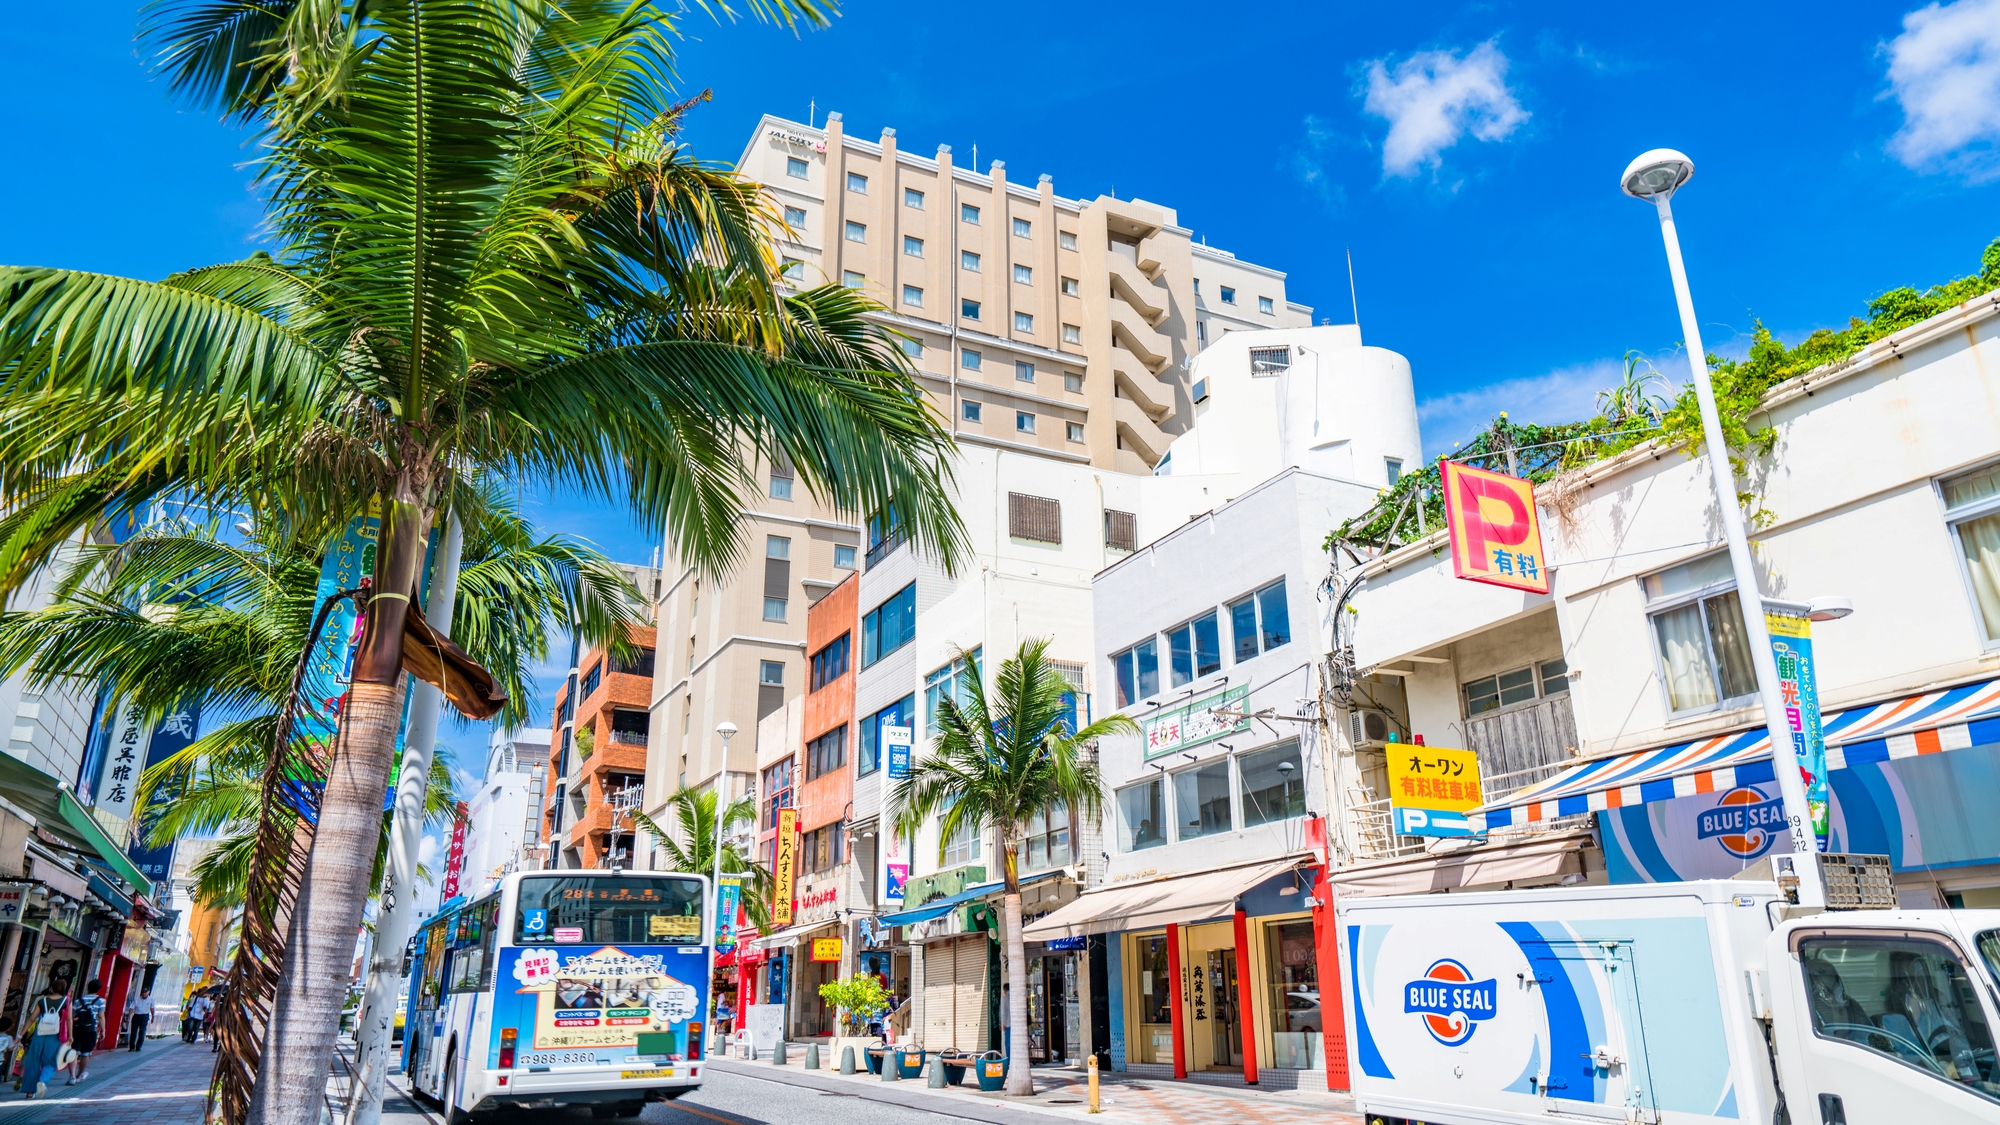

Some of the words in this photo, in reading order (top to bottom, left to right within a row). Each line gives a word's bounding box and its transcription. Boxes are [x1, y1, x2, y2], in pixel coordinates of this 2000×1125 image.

[768, 131, 787, 140] JAL
[788, 135, 814, 146] CITY
[1457, 471, 1530, 572] P
[1492, 548, 1538, 581] 有料
[1800, 656, 1819, 758] おもてなしの心を大切に
[1409, 756, 1464, 777] オーワン
[1400, 775, 1480, 803] 有料駐車場
[1402, 808, 1428, 833] P
[1703, 811, 1744, 833] BLUE
[564, 890, 583, 898] 28
[525, 957, 550, 969] 見積り
[526, 967, 550, 979] 無料
[1410, 987, 1448, 1008] BLUE
[1452, 988, 1493, 1011] SEAL
[552, 1034, 633, 1045] 沖縄リフォームセンター
[532, 1052, 595, 1065] 988-8360
